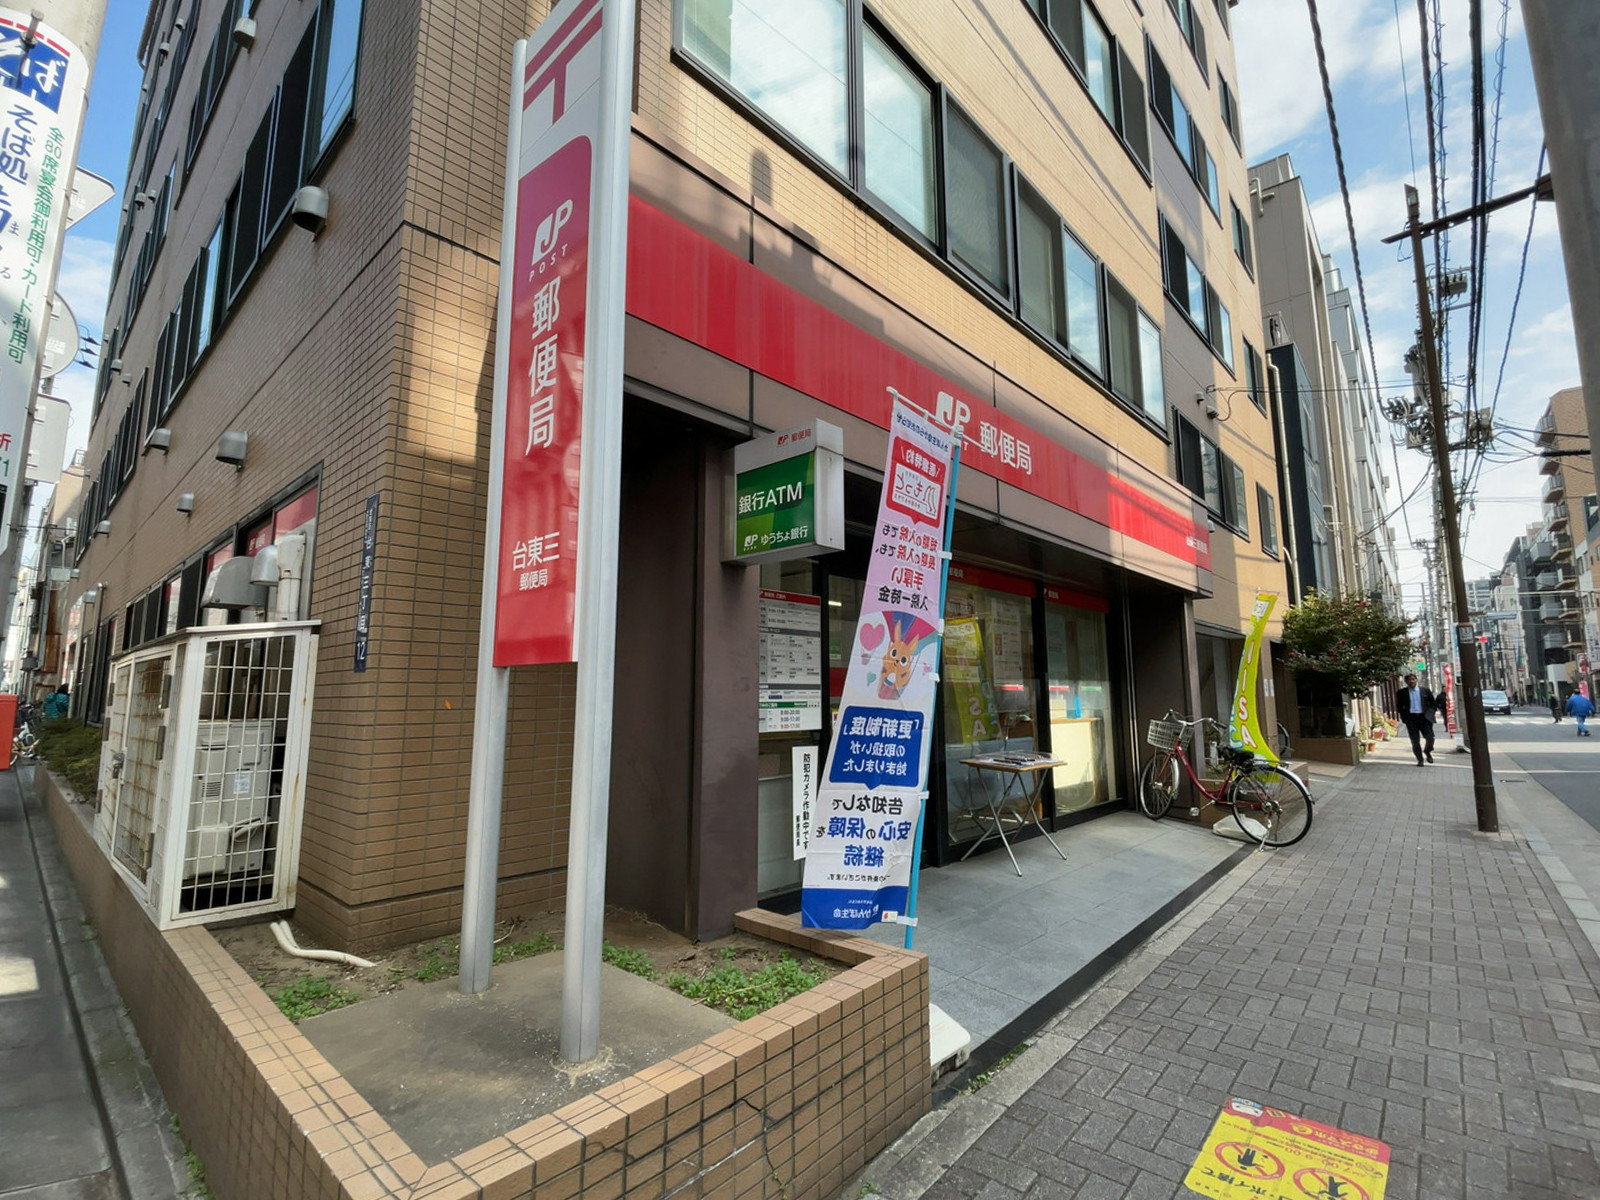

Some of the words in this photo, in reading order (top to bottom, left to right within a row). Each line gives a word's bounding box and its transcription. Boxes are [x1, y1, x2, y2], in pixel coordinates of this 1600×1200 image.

[531, 199, 574, 266] JP
[529, 244, 568, 282] POST
[525, 276, 561, 456] 郵便局
[978, 420, 1032, 475] 郵便局
[739, 481, 803, 514] 銀行ATM
[512, 531, 560, 572] 台東三
[761, 525, 809, 546] ゆうちょ銀行
[519, 568, 549, 592] 郵便局
[357, 641, 366, 660] 12
